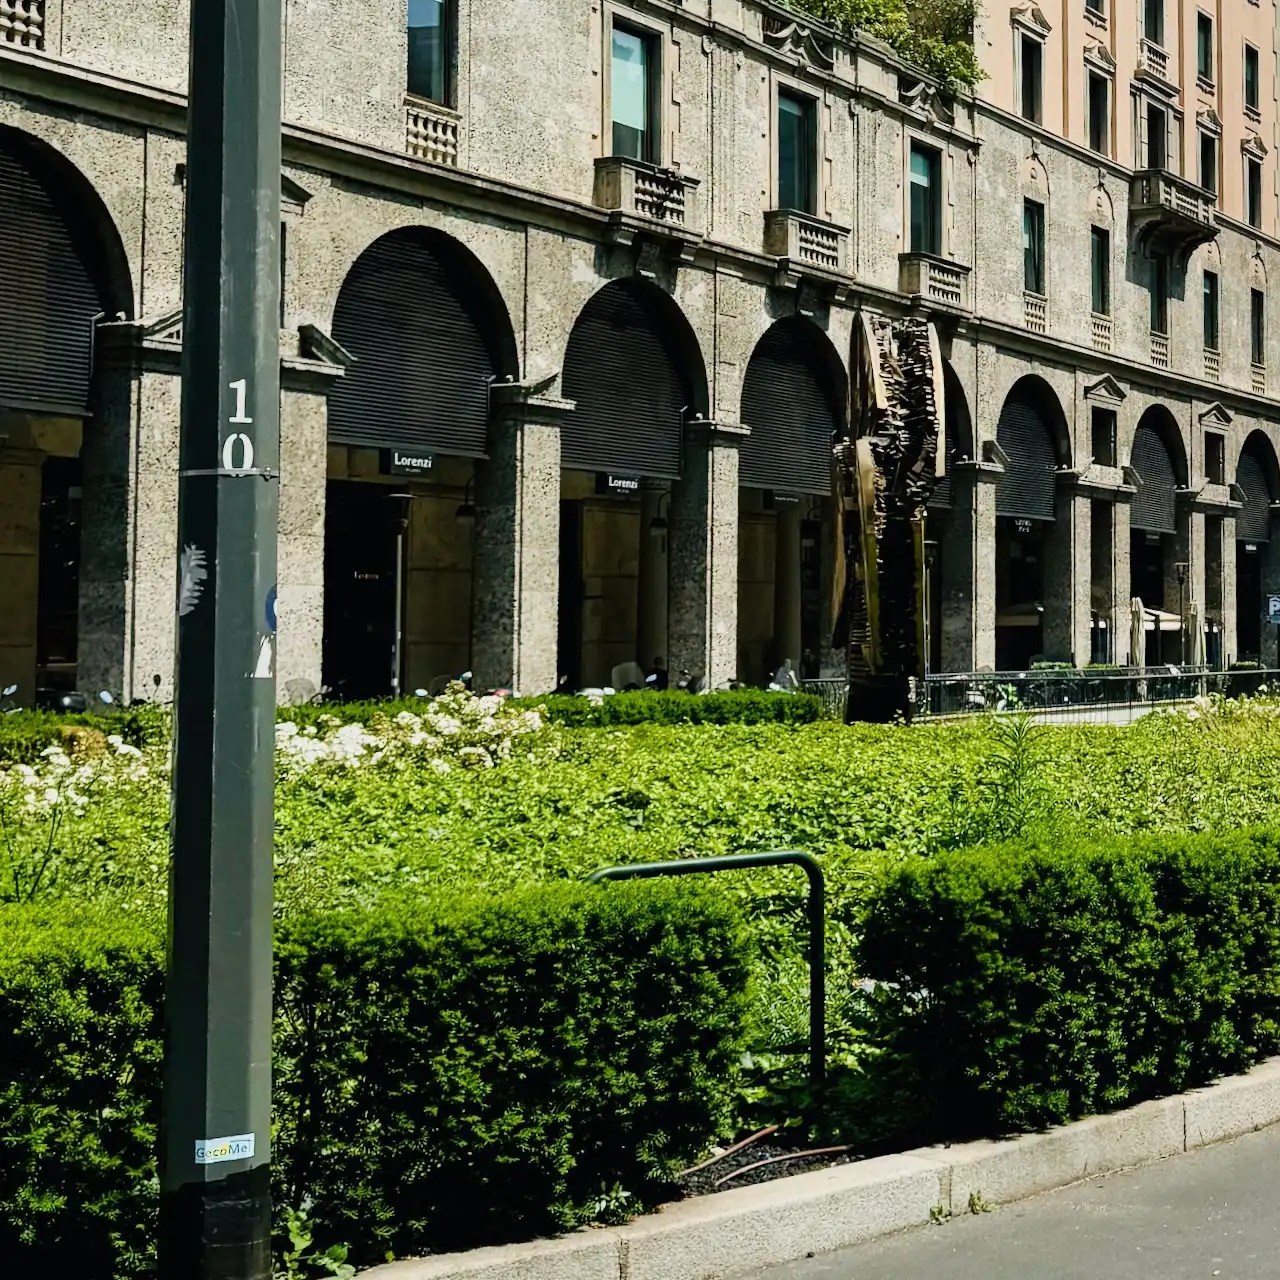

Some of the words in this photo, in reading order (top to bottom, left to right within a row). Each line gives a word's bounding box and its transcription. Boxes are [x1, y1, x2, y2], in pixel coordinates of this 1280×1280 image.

[222, 378, 254, 477] 10
[394, 452, 432, 469] Lorenzi
[608, 475, 638, 489] Lorenzi
[1269, 600, 1280, 616] P
